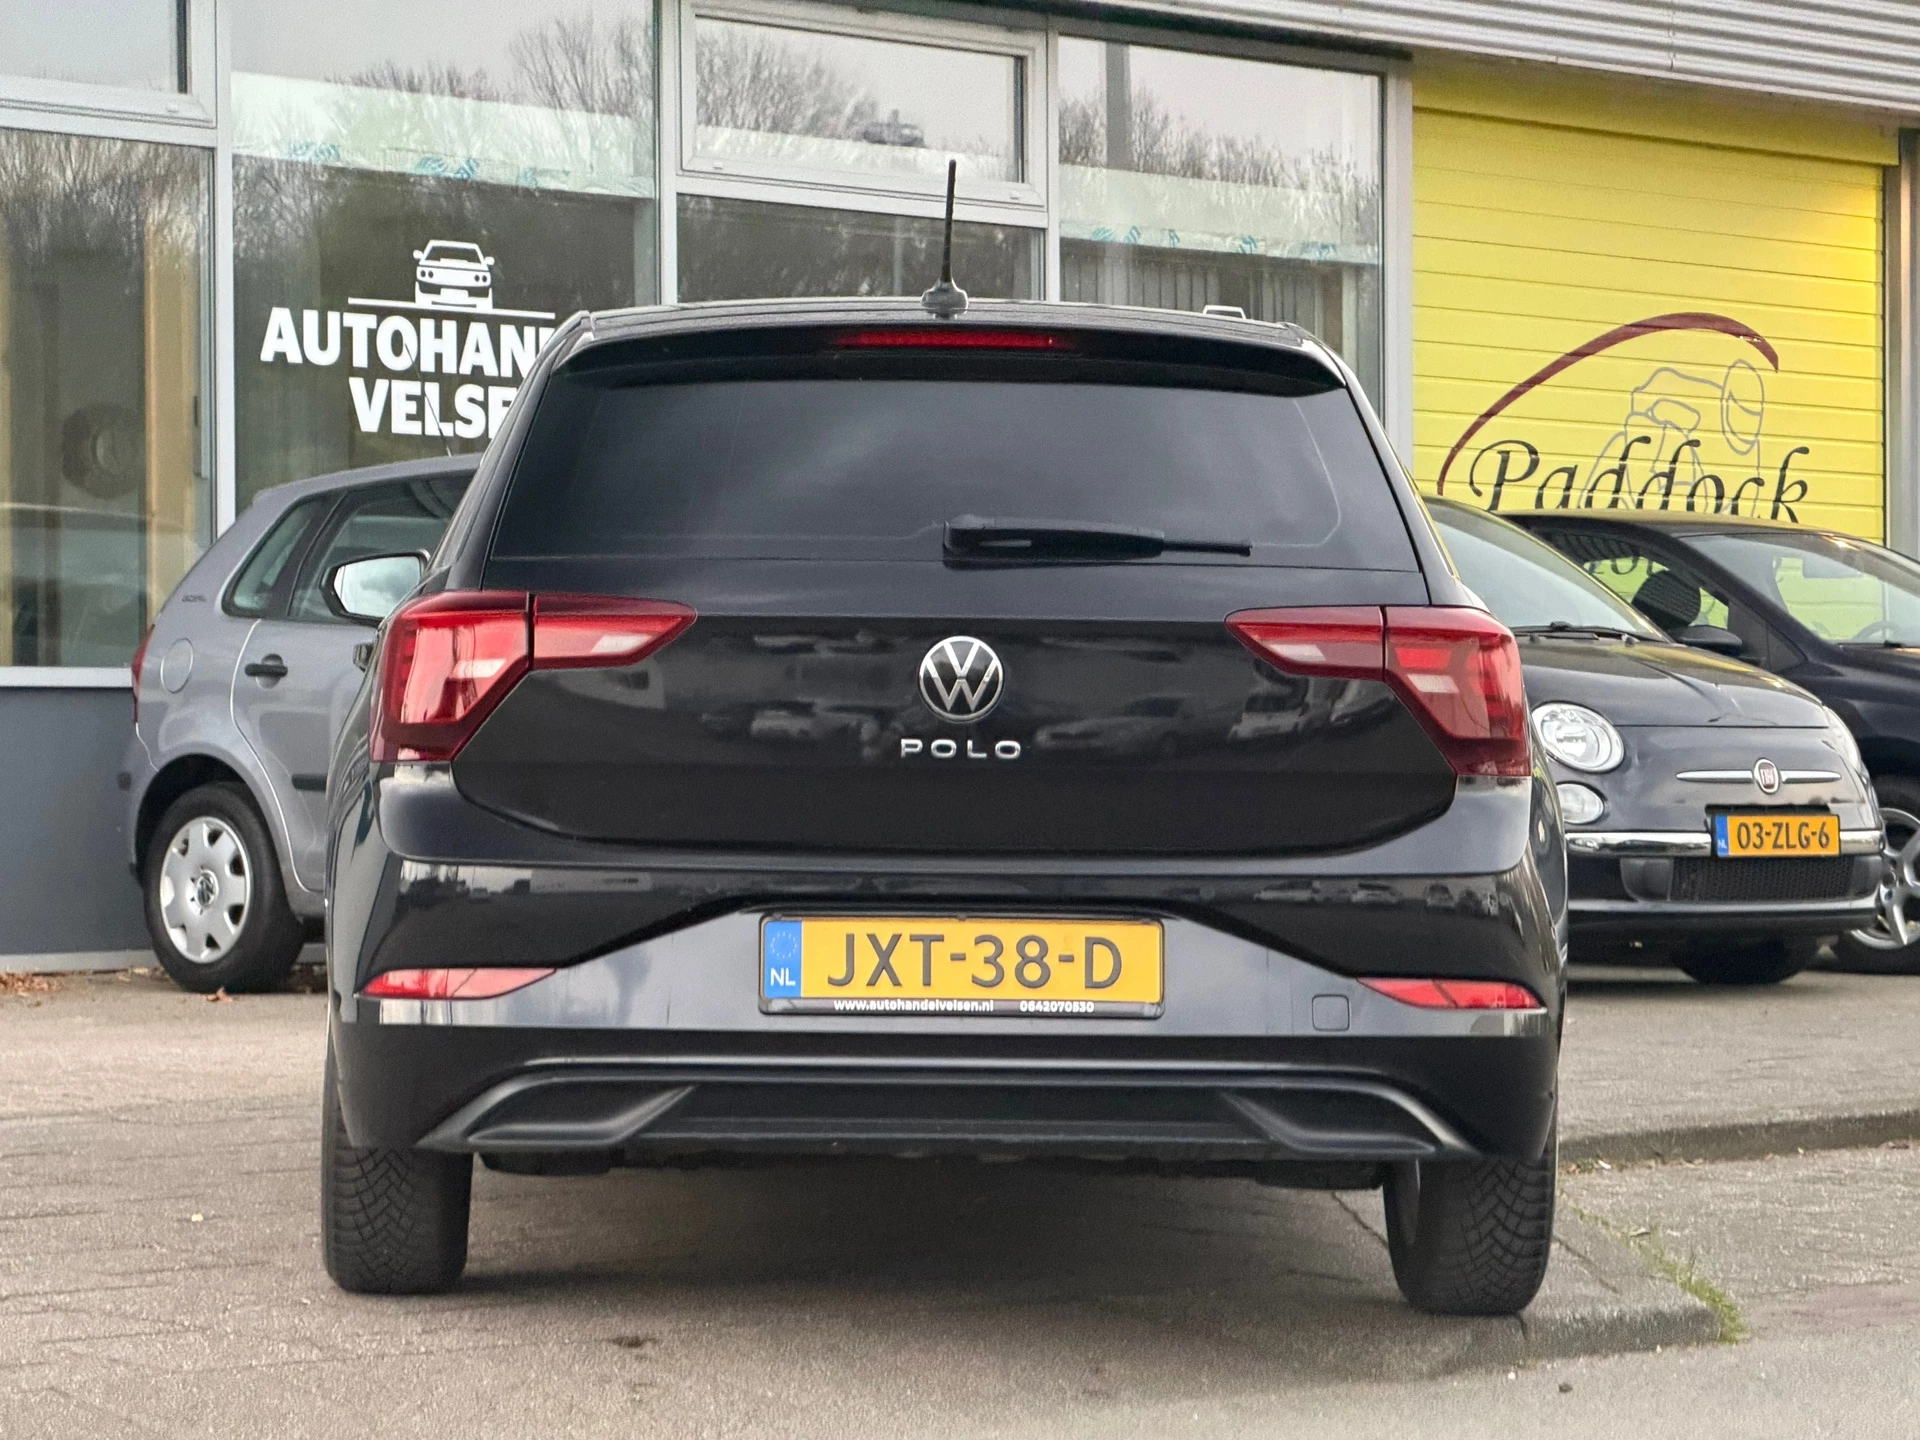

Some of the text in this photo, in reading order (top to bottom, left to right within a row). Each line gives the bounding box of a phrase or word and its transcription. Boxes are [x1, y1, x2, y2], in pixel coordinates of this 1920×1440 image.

[1469, 435, 1809, 523] Paddock
[900, 738, 1022, 760] POLO
[1736, 821, 1831, 850] 03-ZLG-6
[826, 932, 1123, 990] JXT-38-D
[770, 967, 797, 987] NL
[833, 999, 994, 1012] www.autohandelvelsen.nl
